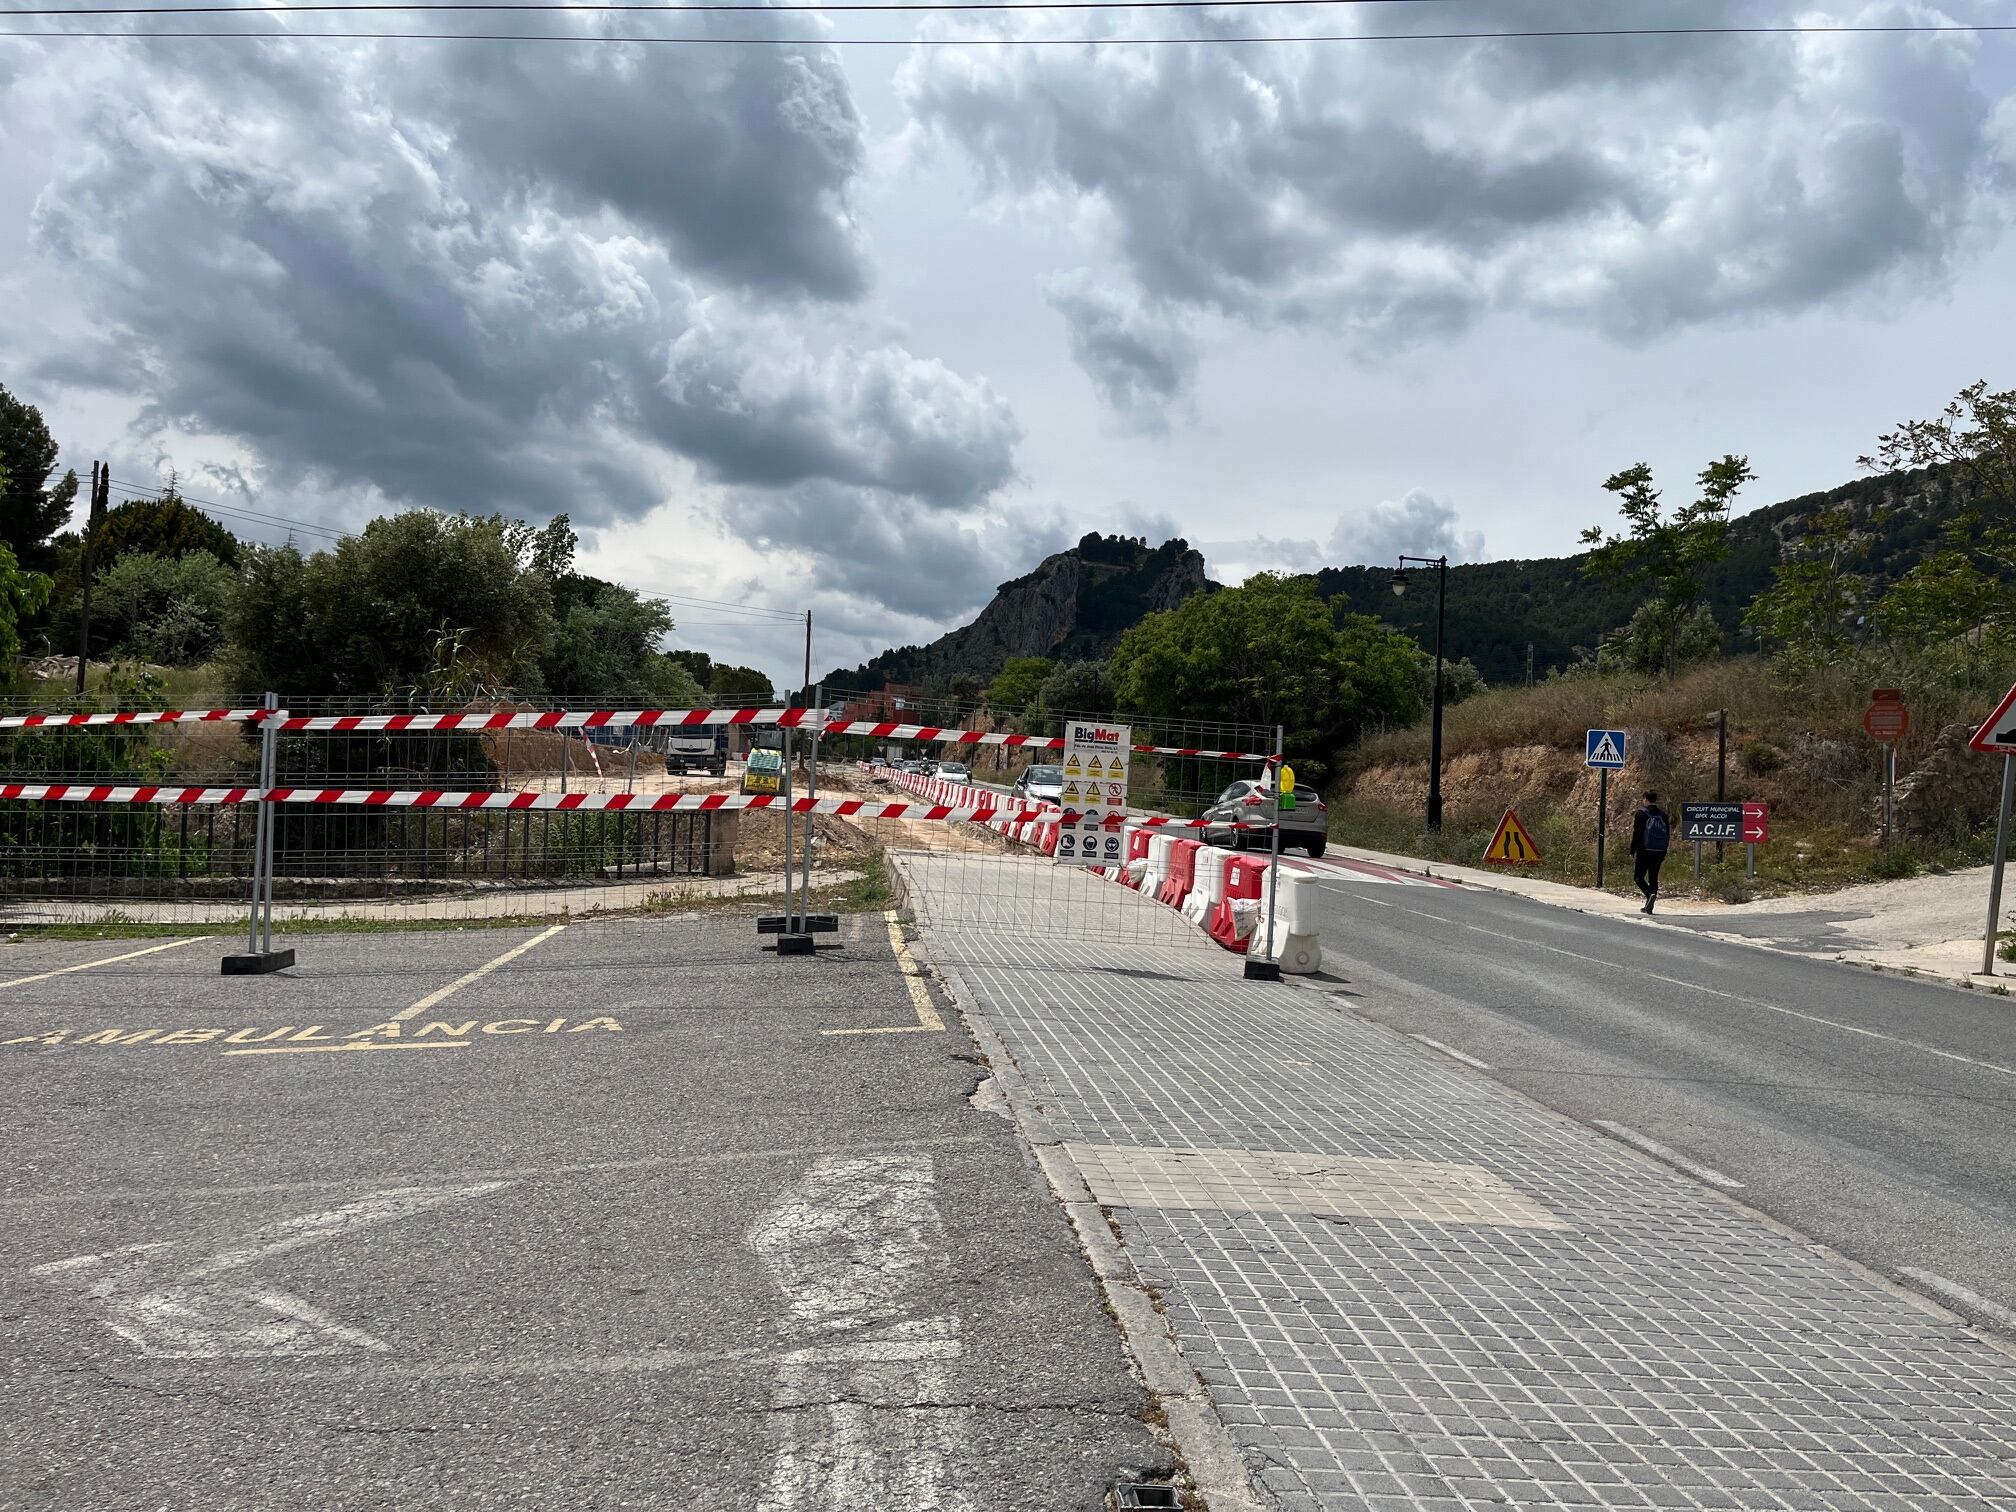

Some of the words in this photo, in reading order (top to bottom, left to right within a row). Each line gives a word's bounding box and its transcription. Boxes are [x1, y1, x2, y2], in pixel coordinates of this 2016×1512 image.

[1074, 727, 1120, 743] BigMat
[1689, 823, 1736, 836] A.C.I.F.
[0, 1016, 624, 1045] AMBULANCIA
